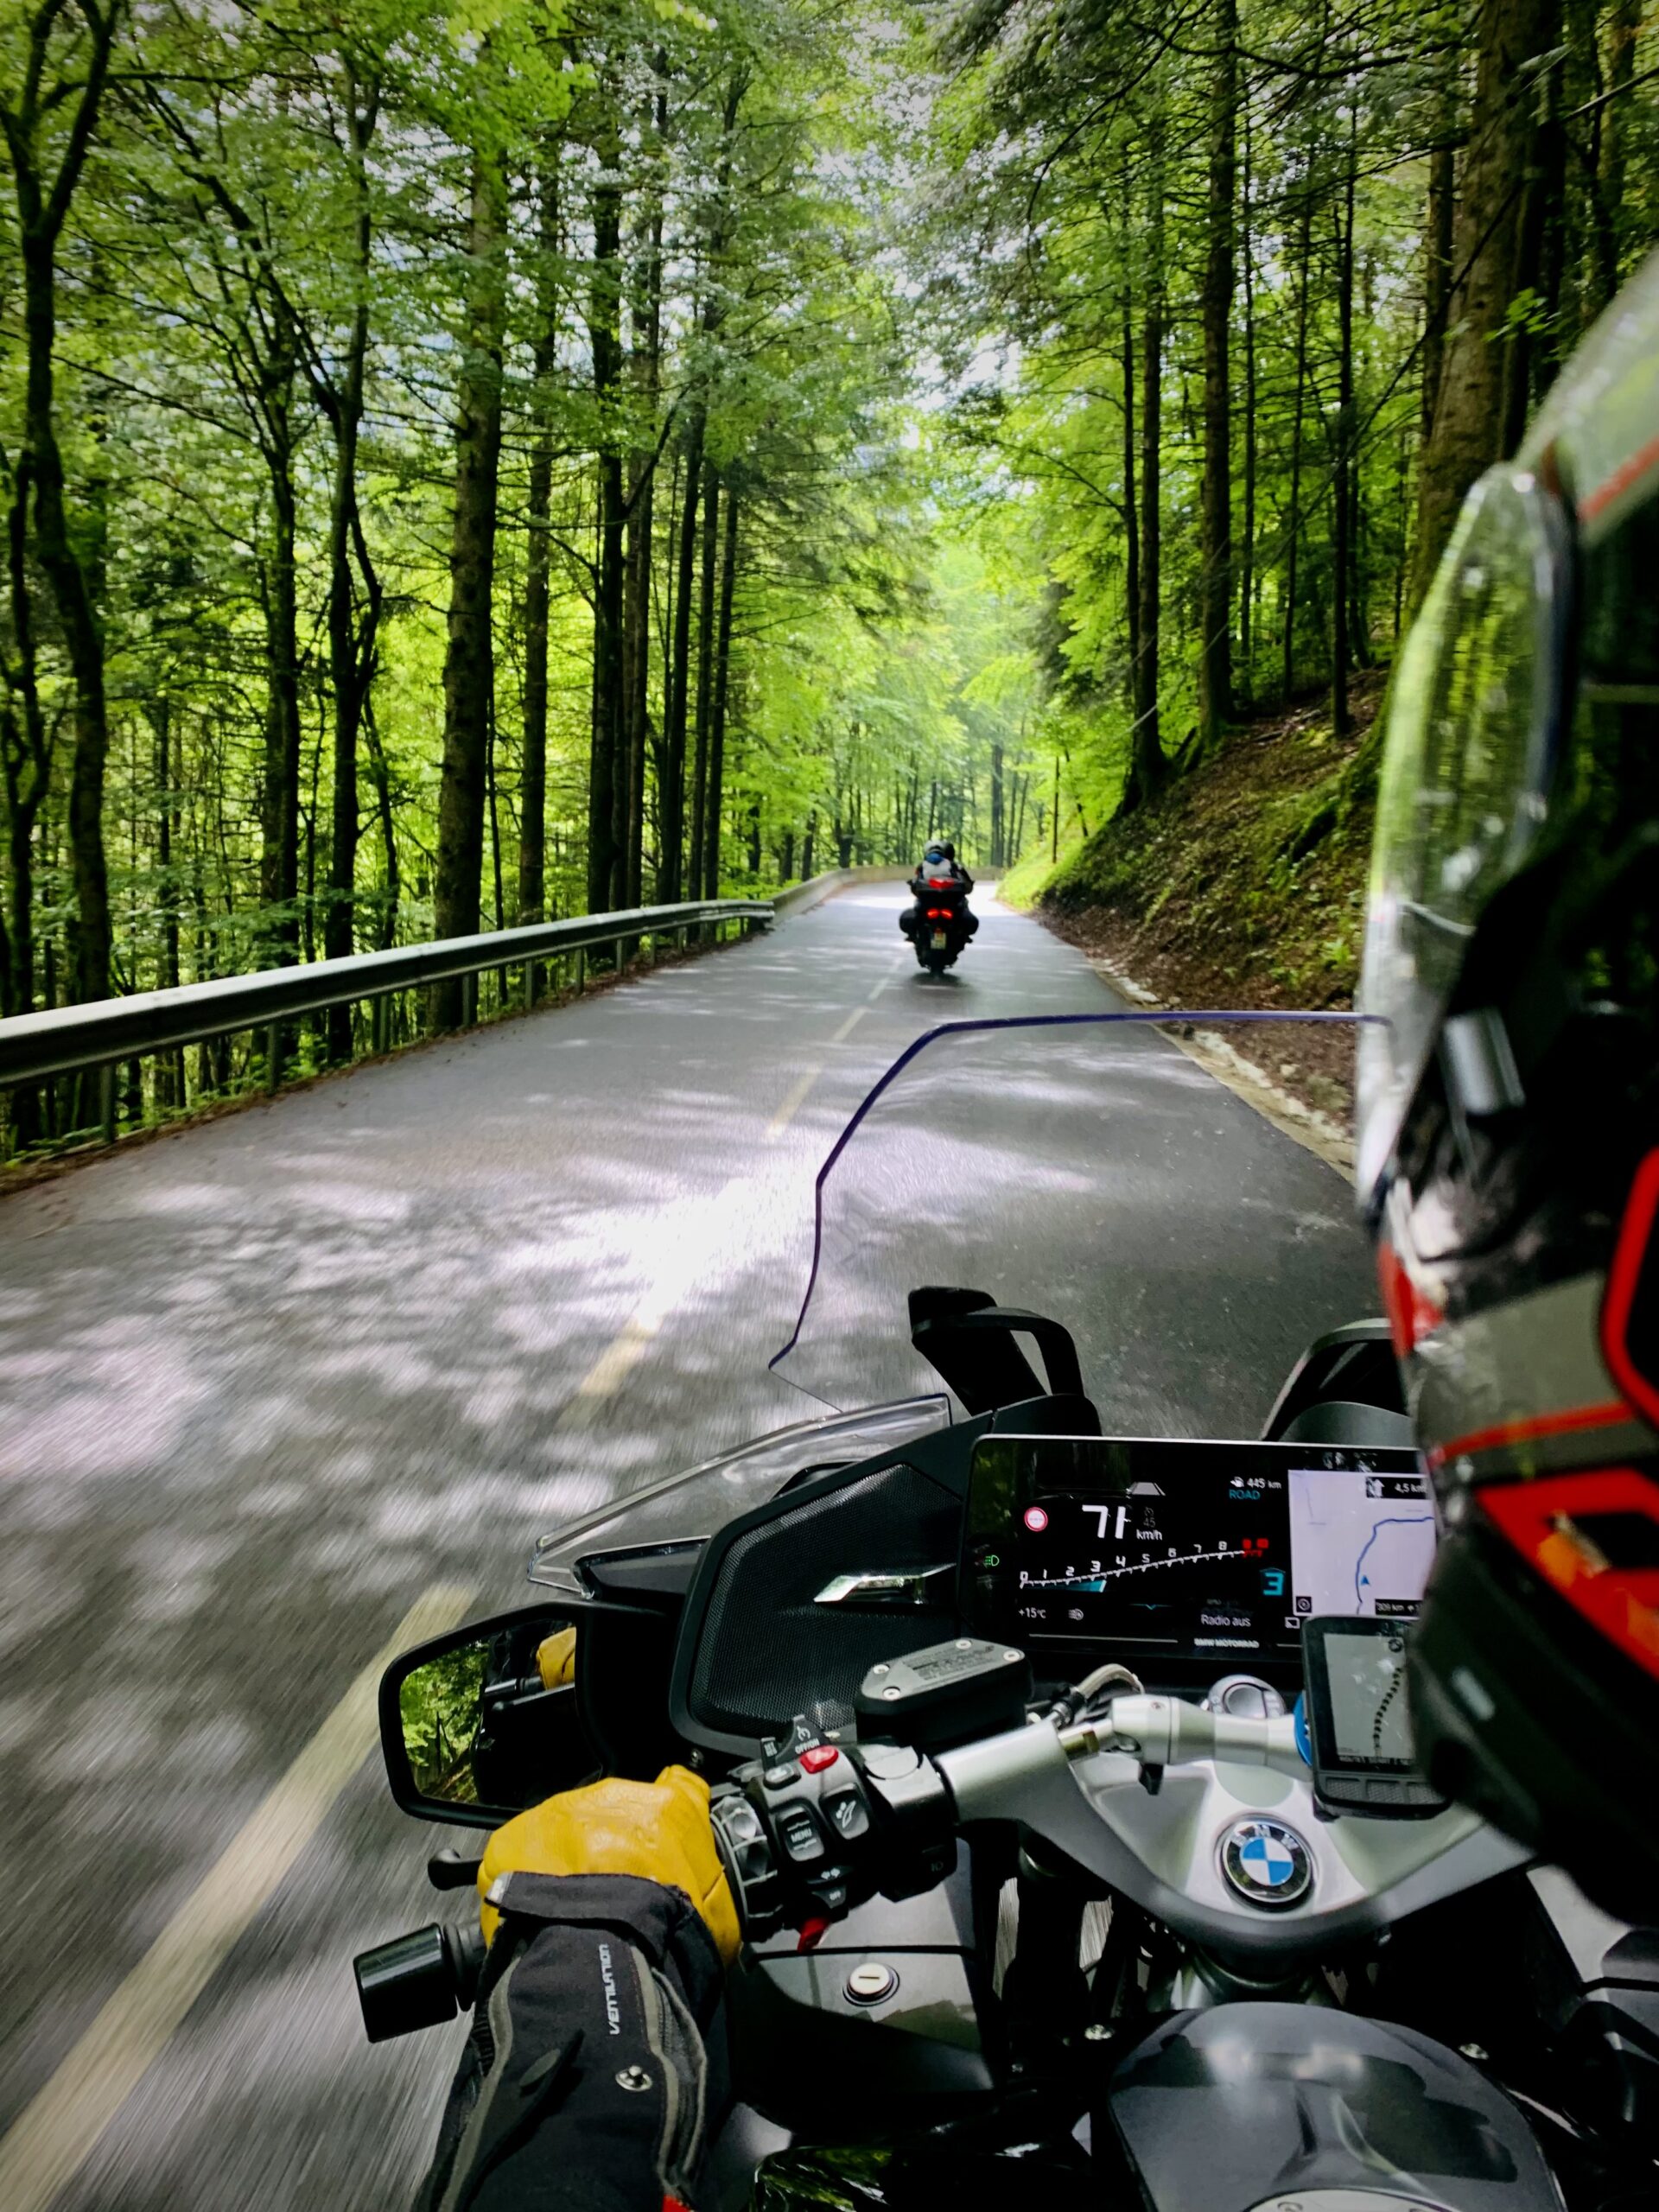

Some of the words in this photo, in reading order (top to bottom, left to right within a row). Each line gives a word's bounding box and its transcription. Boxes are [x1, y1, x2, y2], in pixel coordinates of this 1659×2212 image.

[1268, 1480, 1282, 1490] km
[1229, 1489, 1261, 1500] ROAD
[1082, 1504, 1126, 1539] 71
[1135, 1529, 1163, 1541] km/h
[1043, 1568, 1047, 1580] 1
[1065, 1566, 1075, 1577] 2
[1090, 1560, 1101, 1573] 3
[1116, 1555, 1126, 1567] 4
[1141, 1553, 1150, 1563] 5
[1193, 1543, 1202, 1554] 7
[1218, 1541, 1227, 1551] 8
[1262, 1572, 1284, 1596] 3
[1200, 1614, 1230, 1626] Radio
[1232, 1617, 1251, 1627] aus
[791, 1827, 812, 1843] MENU
[1230, 1824, 1300, 1849] BMW
